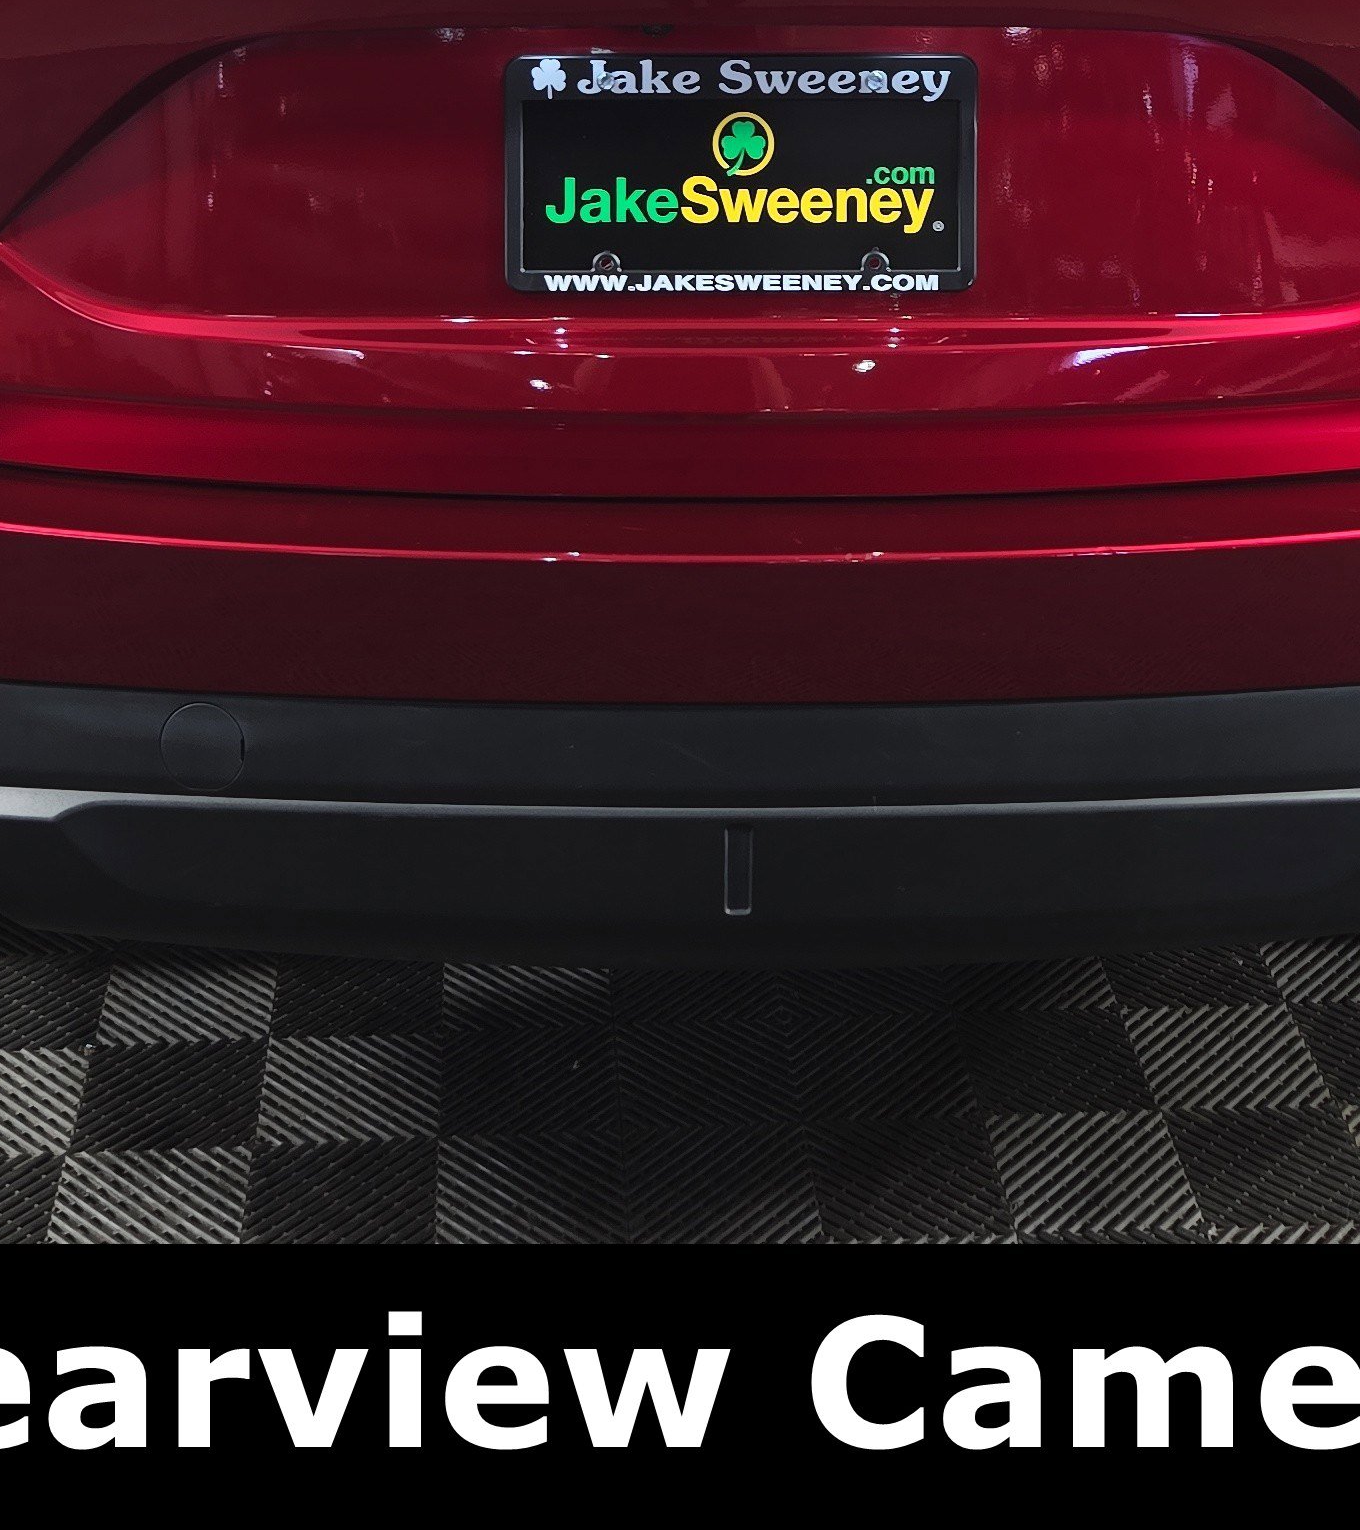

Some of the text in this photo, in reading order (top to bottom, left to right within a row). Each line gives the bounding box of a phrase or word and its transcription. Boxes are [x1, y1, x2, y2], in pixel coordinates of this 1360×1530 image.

[577, 59, 951, 103] Jake Sweeney
[544, 274, 940, 293] WWW.JAKESWEENEY.COM
